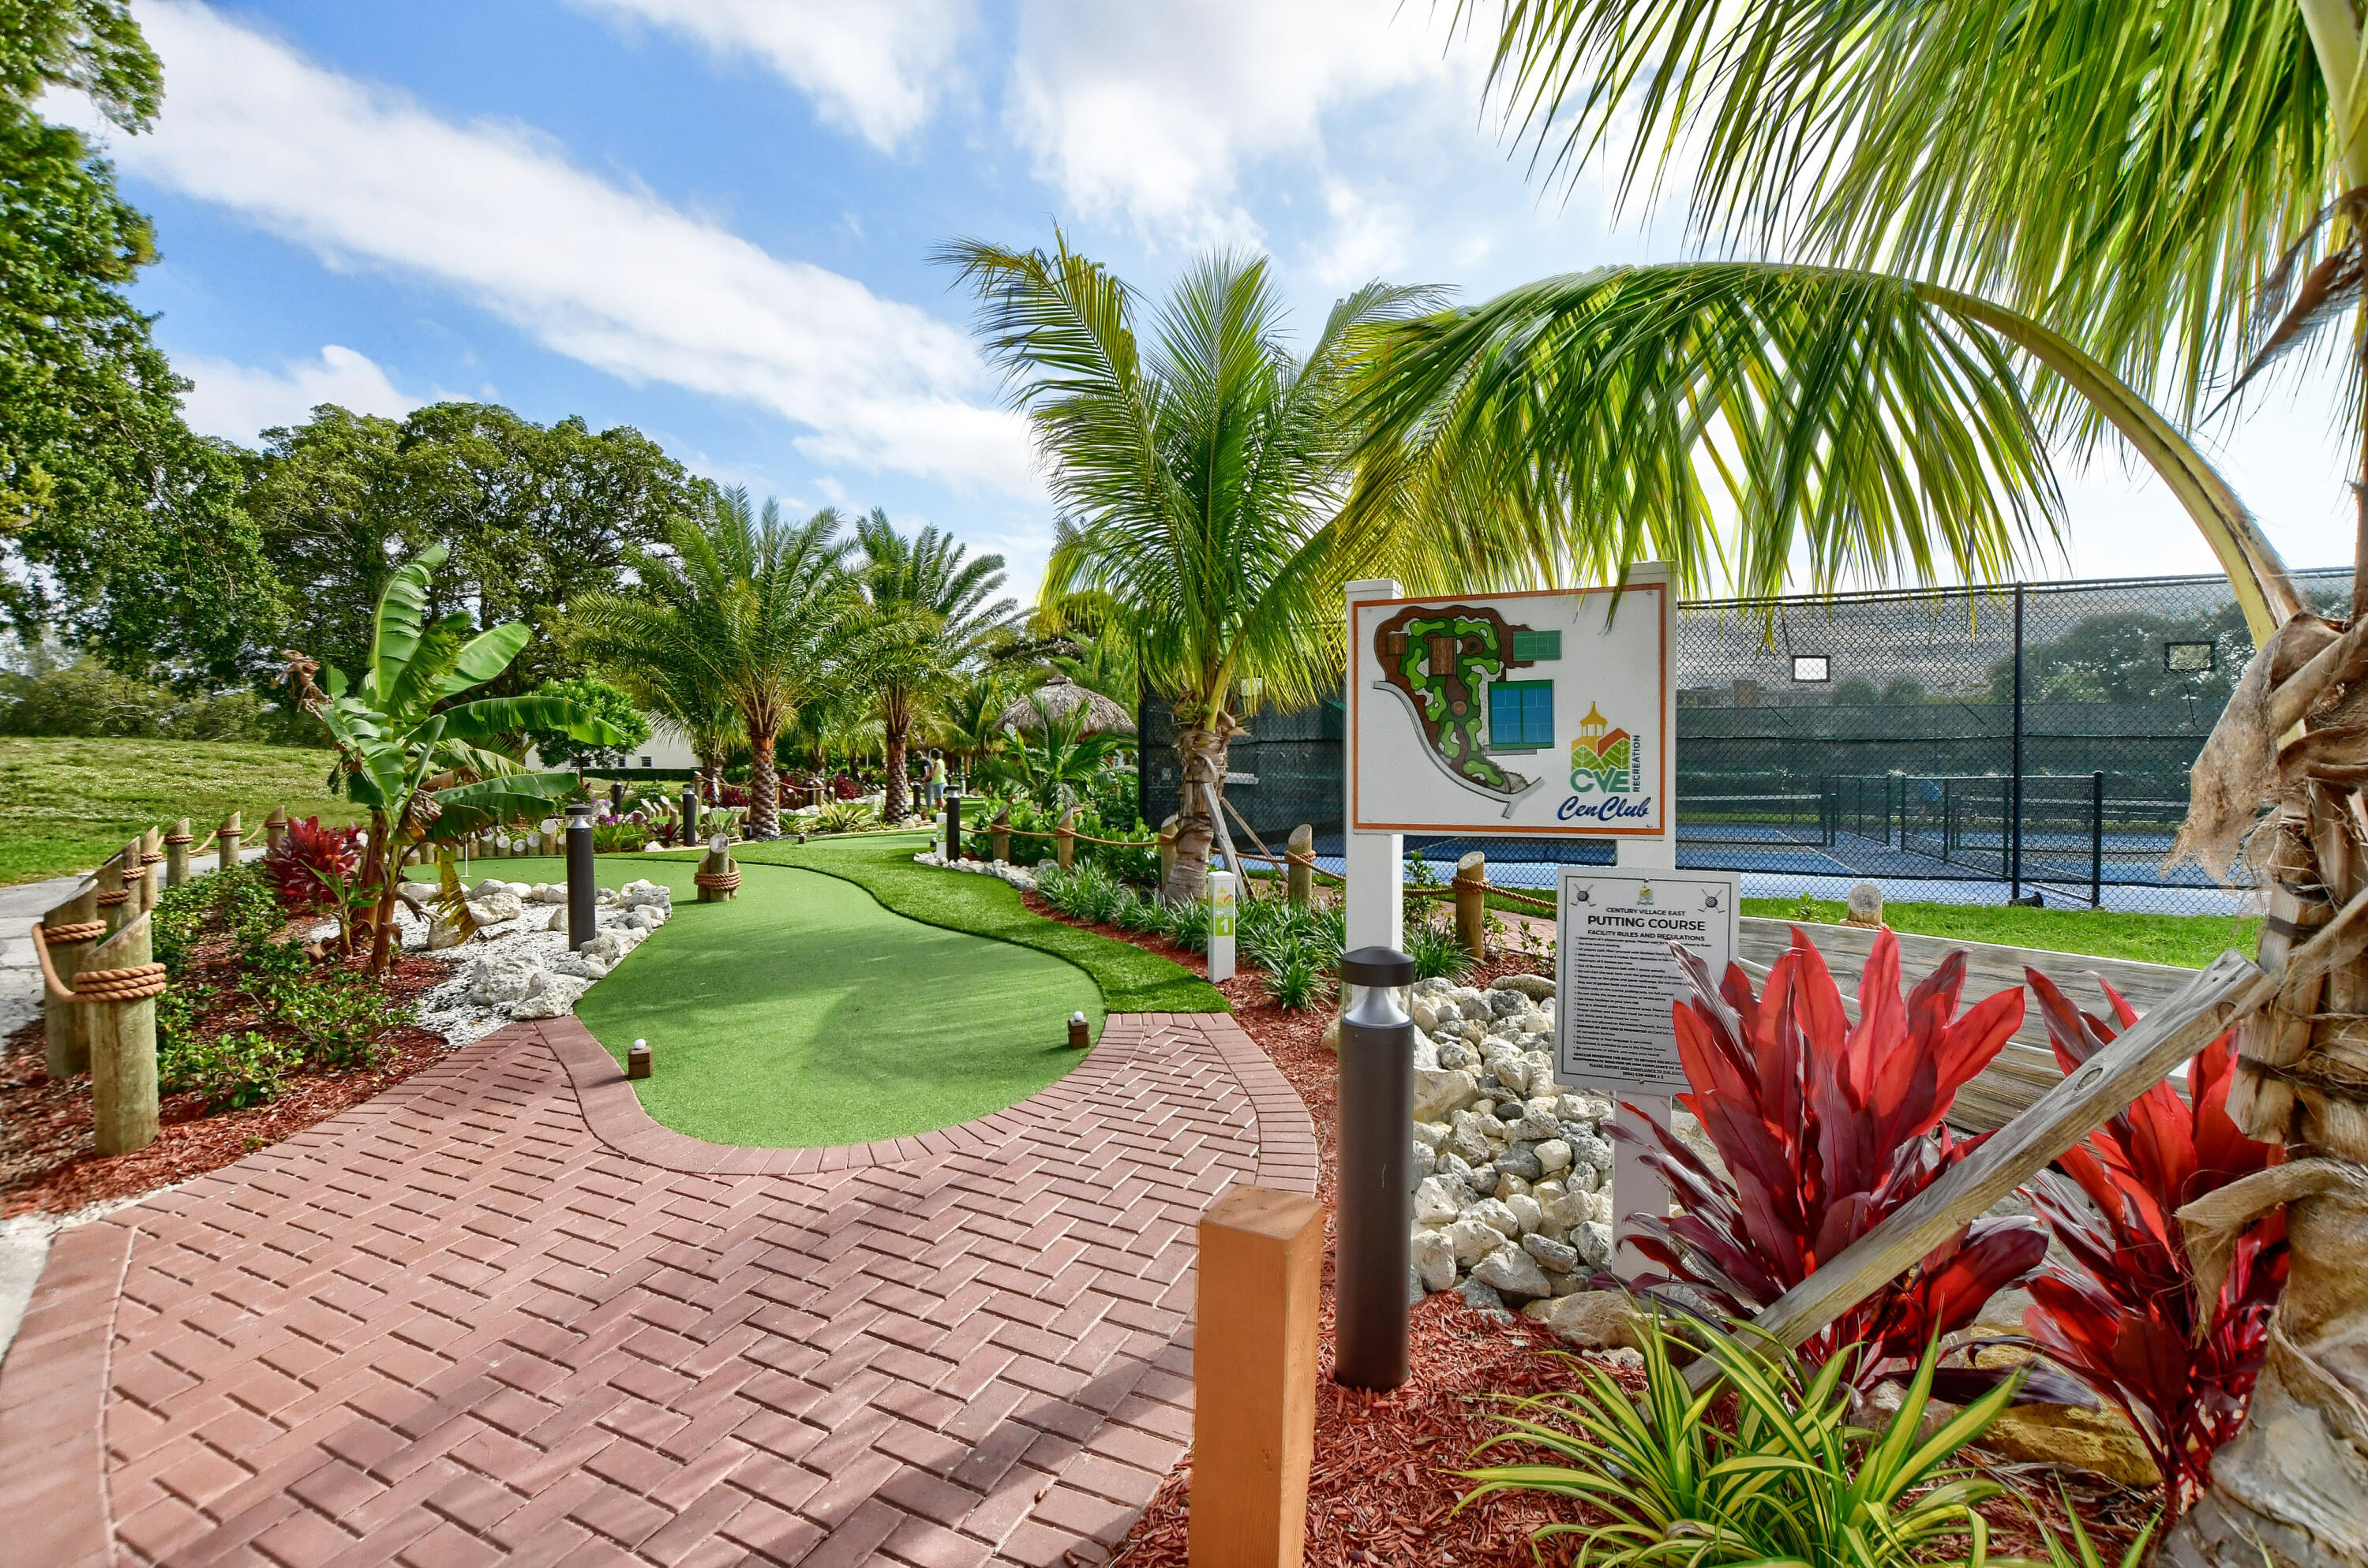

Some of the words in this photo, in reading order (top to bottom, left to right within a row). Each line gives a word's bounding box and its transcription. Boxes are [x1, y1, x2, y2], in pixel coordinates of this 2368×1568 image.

[1632, 735, 1641, 793] RECREATION
[1570, 765, 1630, 794] CVE
[1557, 795, 1652, 821] CenClub
[1220, 919, 1229, 933] 1
[1587, 915, 1645, 927] PUTTING
[1648, 919, 1706, 930] COURSE
